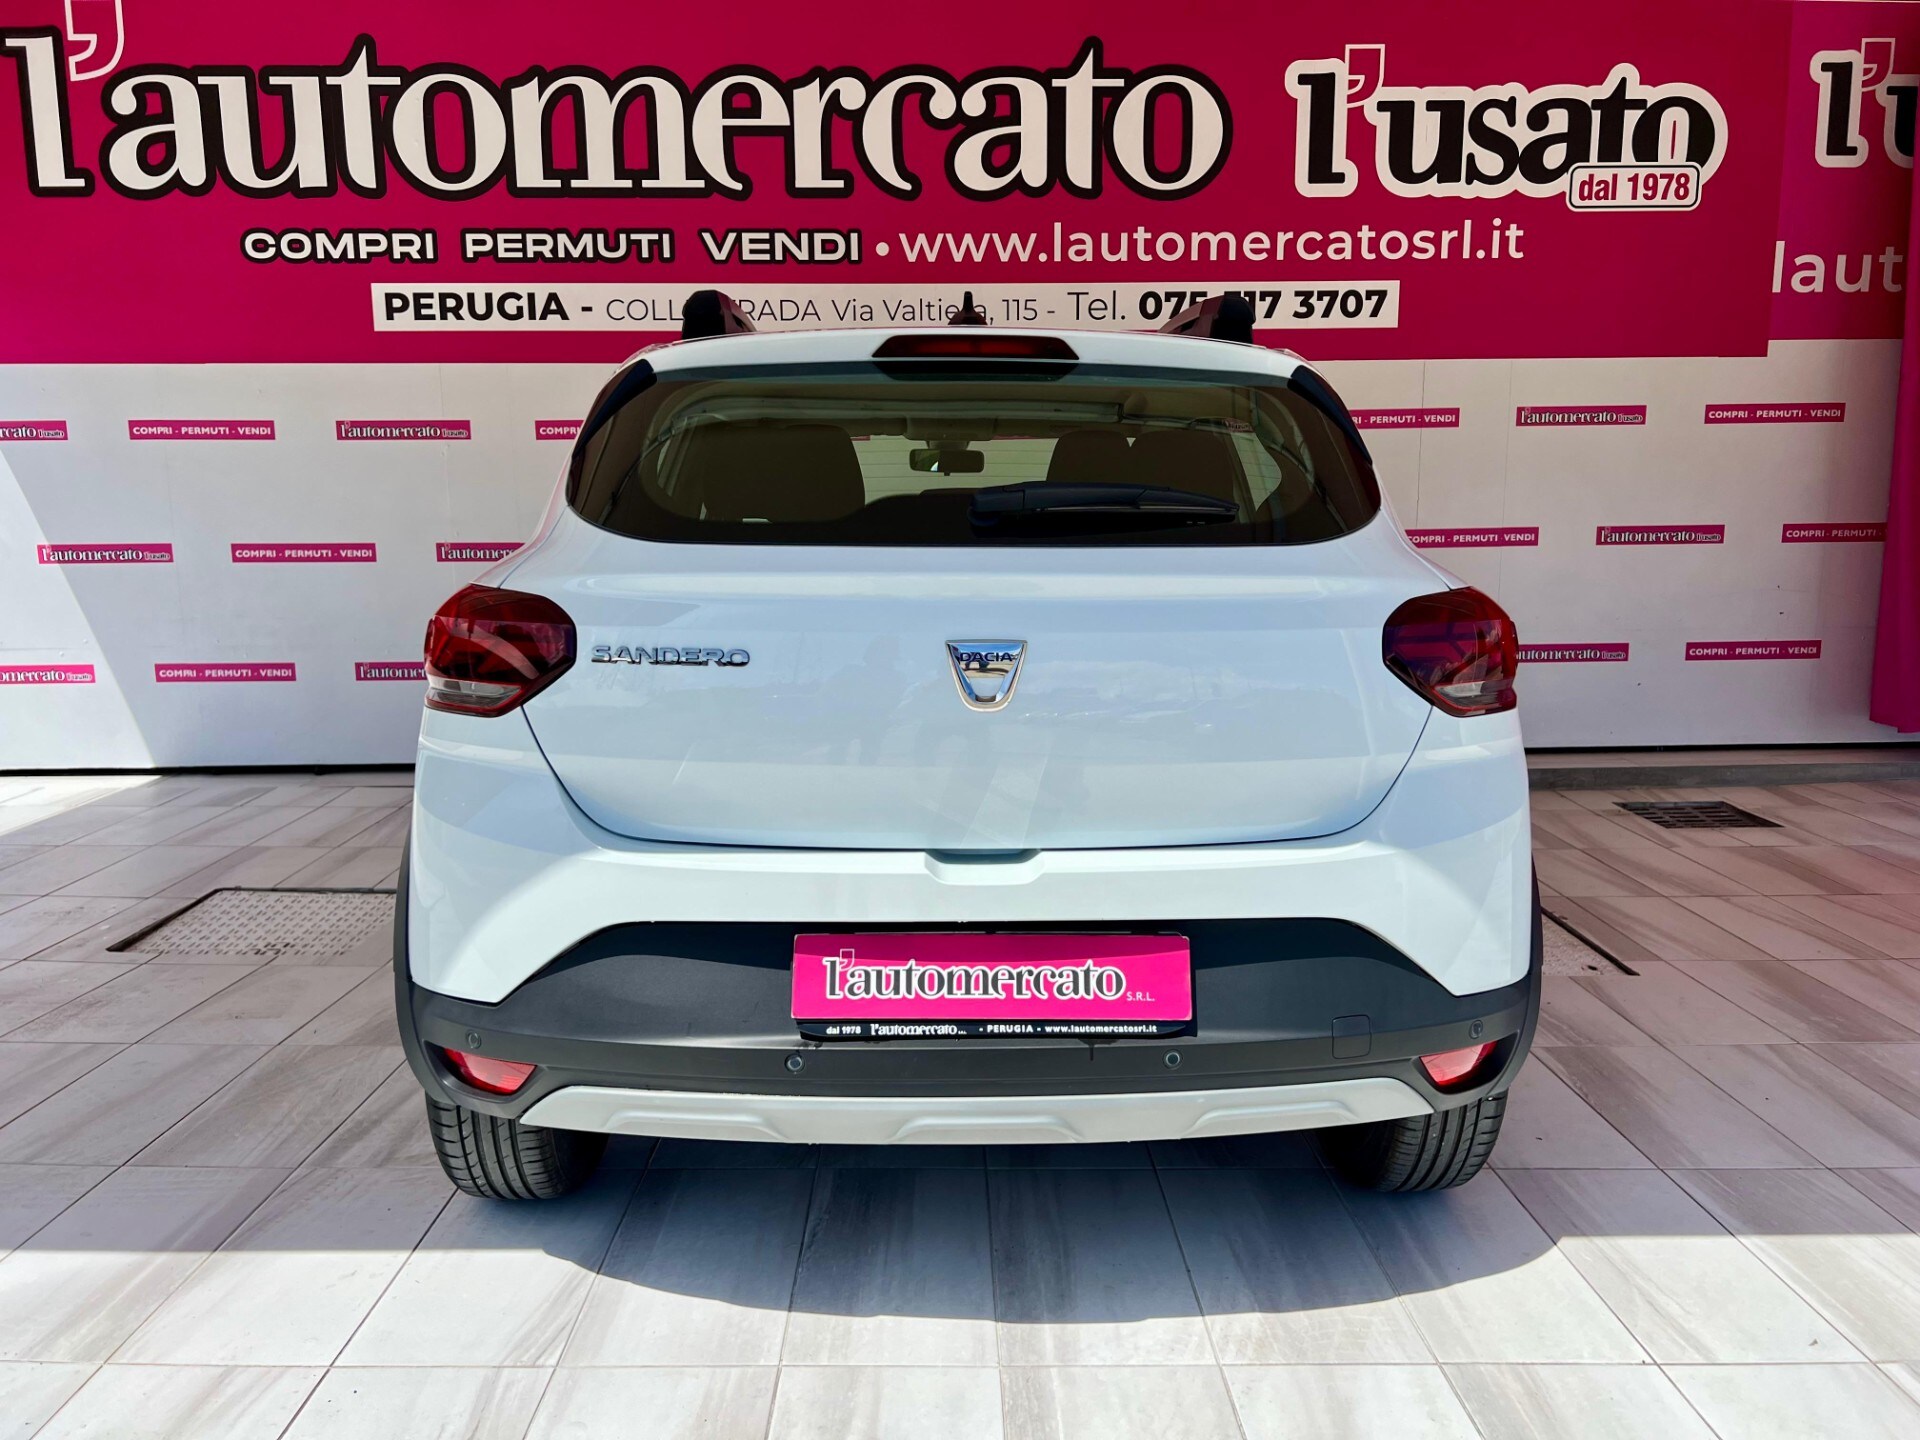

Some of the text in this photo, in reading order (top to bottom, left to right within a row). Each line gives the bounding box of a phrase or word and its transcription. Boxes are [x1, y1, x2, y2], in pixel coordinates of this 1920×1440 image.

[3, 0, 1230, 198] l'automercato
[1288, 44, 1724, 193] l'usato
[1578, 173, 1691, 201] dal 1978
[242, 217, 1524, 263] COMPRI PERMUTI VENDI www.lautomercatosrl.it
[385, 291, 569, 321] PERUGIA
[606, 299, 821, 321] COLLRADA
[831, 297, 874, 321] Via
[882, 297, 994, 325] Valtiea,
[1002, 299, 1038, 321] 115
[1067, 290, 1126, 320] Tel.
[1292, 290, 1388, 319] 3707
[1370, 415, 1416, 424] PERMUTI
[1424, 414, 1455, 422] VENDI
[1521, 407, 1616, 423] l'automercato
[1708, 410, 1748, 418] COMPRI
[1756, 409, 1802, 418] PERMUTI
[1810, 409, 1841, 417] VENDI
[133, 426, 172, 435] COMPRI
[181, 426, 229, 435] PERMUTI
[237, 426, 271, 435] VENDI
[341, 420, 440, 438] l'automercato
[1453, 534, 1498, 542] PERMUTI
[1504, 533, 1535, 541] VENDI
[1601, 526, 1695, 543] l'automercato
[1786, 530, 1825, 538] COMPRI
[1832, 529, 1877, 537] PERMUTI
[42, 544, 142, 561] l'automercato
[235, 549, 276, 558] COMPRI
[285, 549, 332, 558] PERMUTI
[340, 549, 372, 557] VENDI
[591, 645, 750, 667] SANDERO
[960, 652, 1012, 662] DACIA
[1689, 648, 1727, 656] COMPRI
[1735, 646, 1779, 655] PERMUTI
[1788, 646, 1817, 654] VENDI
[159, 669, 196, 678] COMPRI
[205, 669, 251, 677] PERMUTI
[260, 668, 292, 677] VENDI
[823, 949, 1155, 1002] l'automercato S.R.L.
[826, 1026, 840, 1035] dal
[842, 1026, 861, 1034] 1978
[870, 1023, 957, 1035] l'automercato
[986, 1025, 1034, 1033] PERUGIA
[1045, 1024, 1158, 1033] www.lautomercatosrl.it
